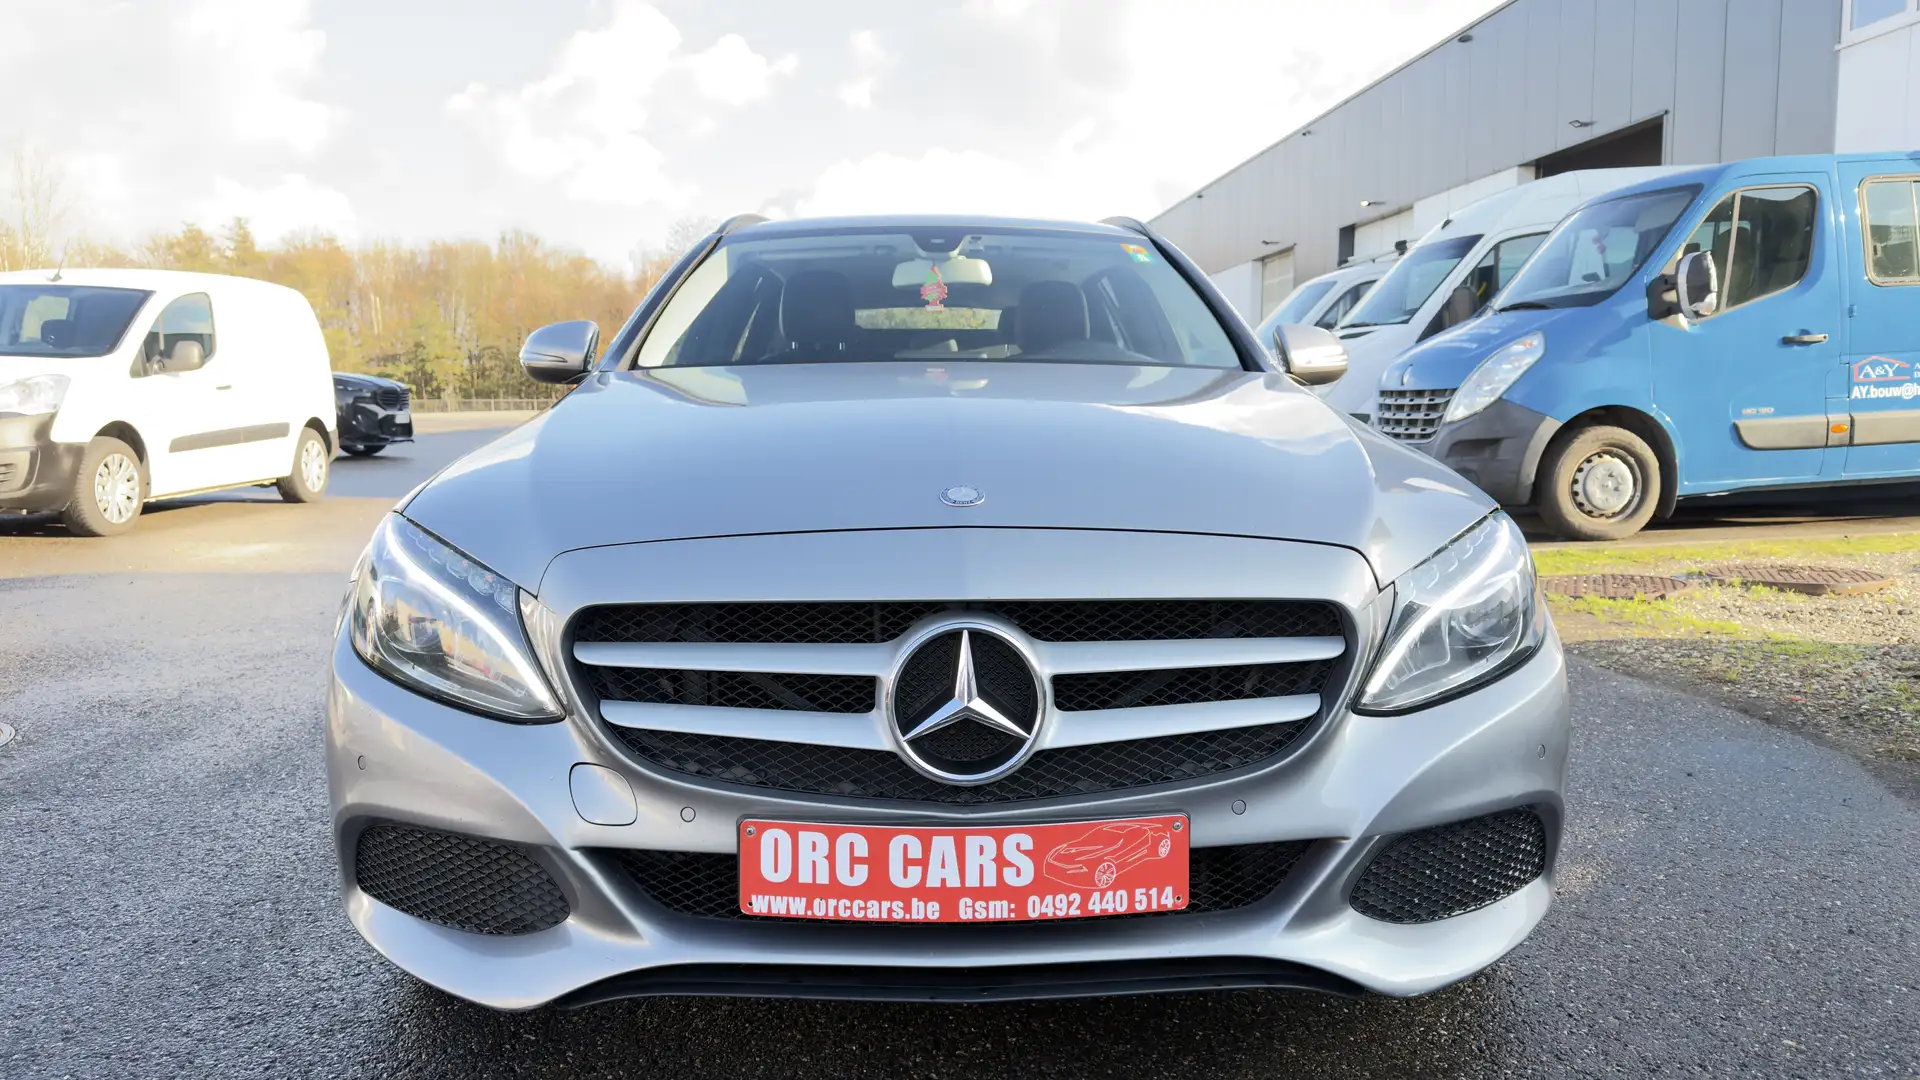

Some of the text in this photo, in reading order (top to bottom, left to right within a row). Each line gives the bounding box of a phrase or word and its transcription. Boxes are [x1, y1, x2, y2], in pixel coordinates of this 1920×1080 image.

[1859, 363, 1899, 378] A&Y
[760, 828, 1035, 889] ORC CARS
[751, 886, 1174, 920] www.orccars.be Gsm: 0492 440 514
